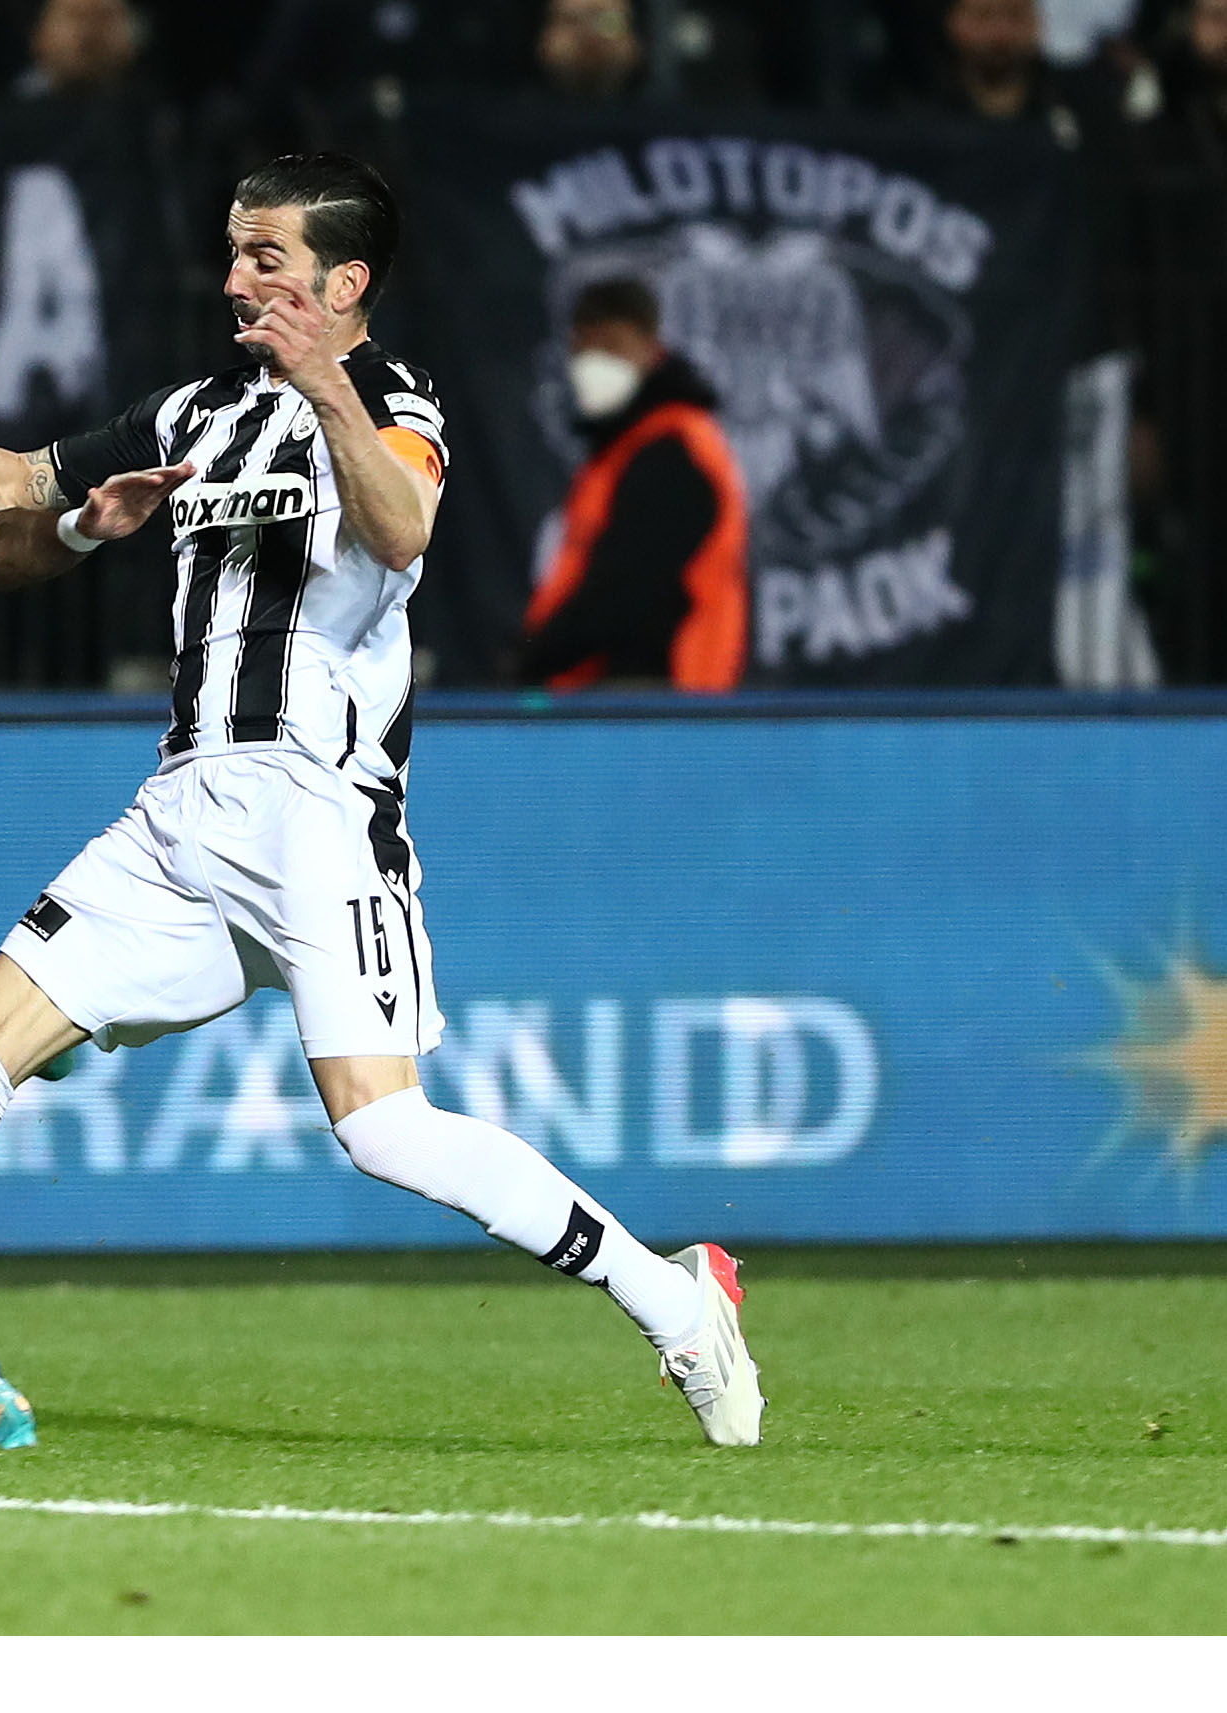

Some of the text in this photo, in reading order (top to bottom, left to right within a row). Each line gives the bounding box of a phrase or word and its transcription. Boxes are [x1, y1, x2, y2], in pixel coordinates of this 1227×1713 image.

[511, 137, 994, 290] MILOTOPOS
[171, 486, 303, 528] oiximan
[758, 528, 970, 666] PAOK
[346, 895, 392, 978] 15
